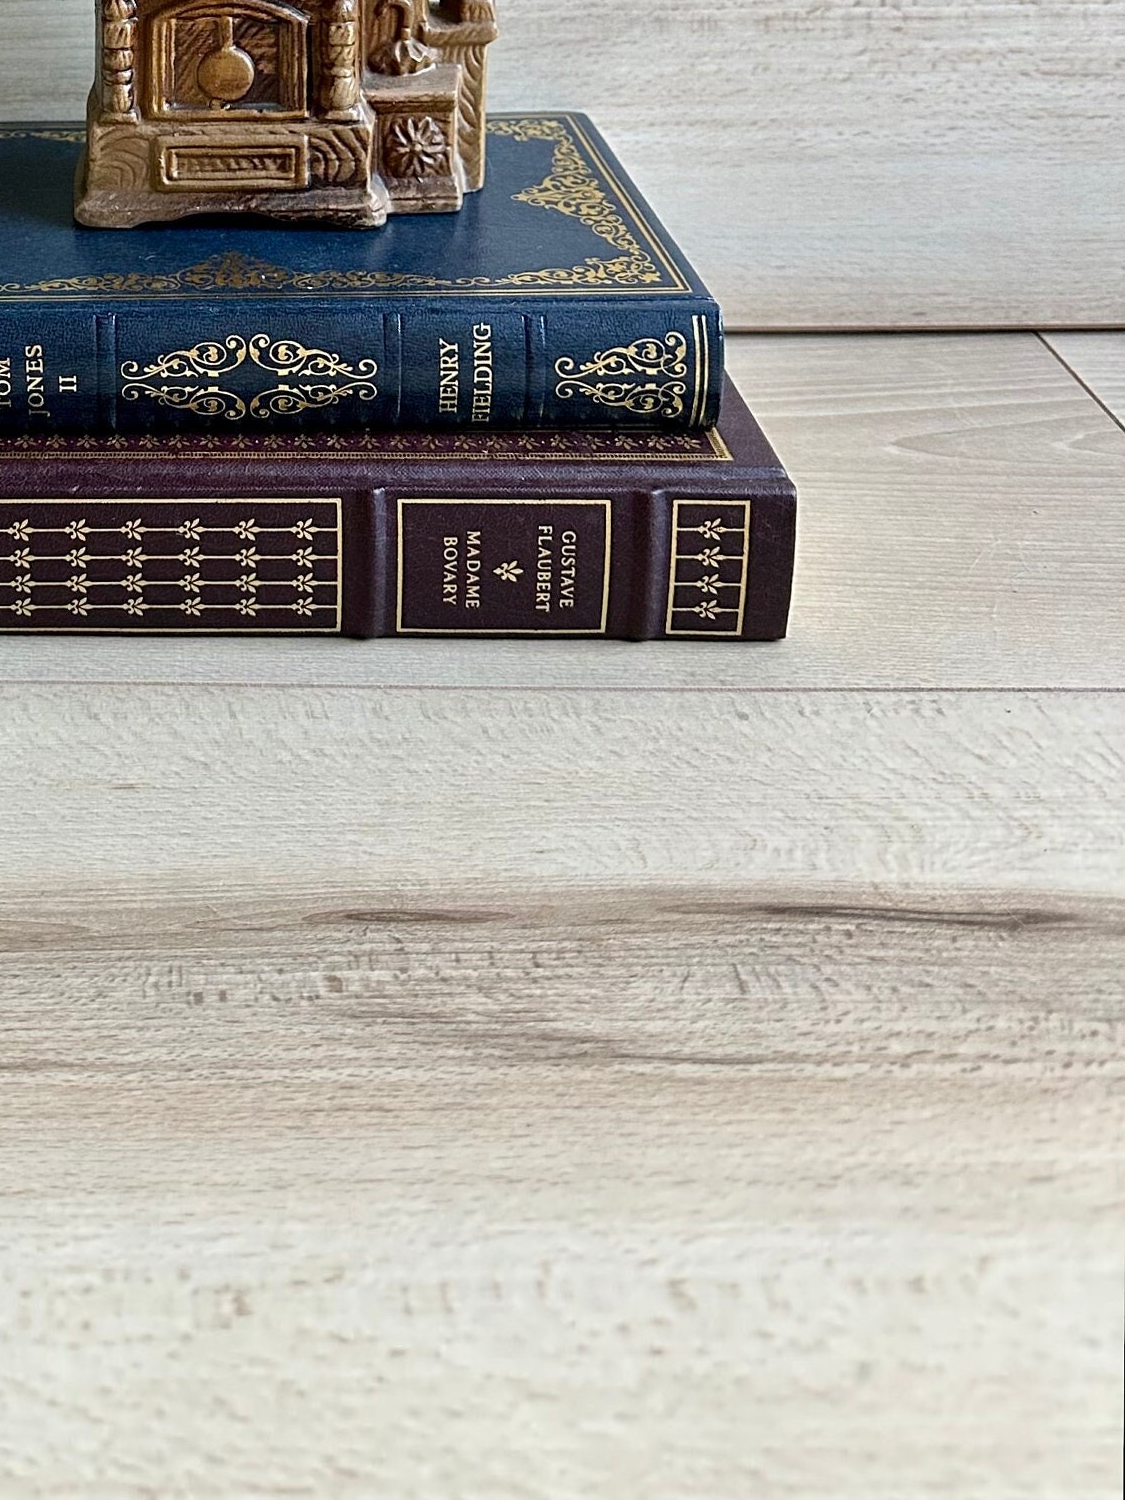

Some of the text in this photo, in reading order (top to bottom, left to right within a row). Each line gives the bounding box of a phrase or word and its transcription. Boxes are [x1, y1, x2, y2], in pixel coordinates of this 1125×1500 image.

[24, 344, 51, 418] JONES
[58, 375, 77, 393] II
[438, 337, 459, 414] HENRY
[471, 322, 493, 423] FIELDING
[442, 536, 458, 606] BOVARY
[465, 530, 481, 609] MADAME
[535, 525, 553, 613] FLAUBERT
[559, 530, 577, 609] GUSTAVE
